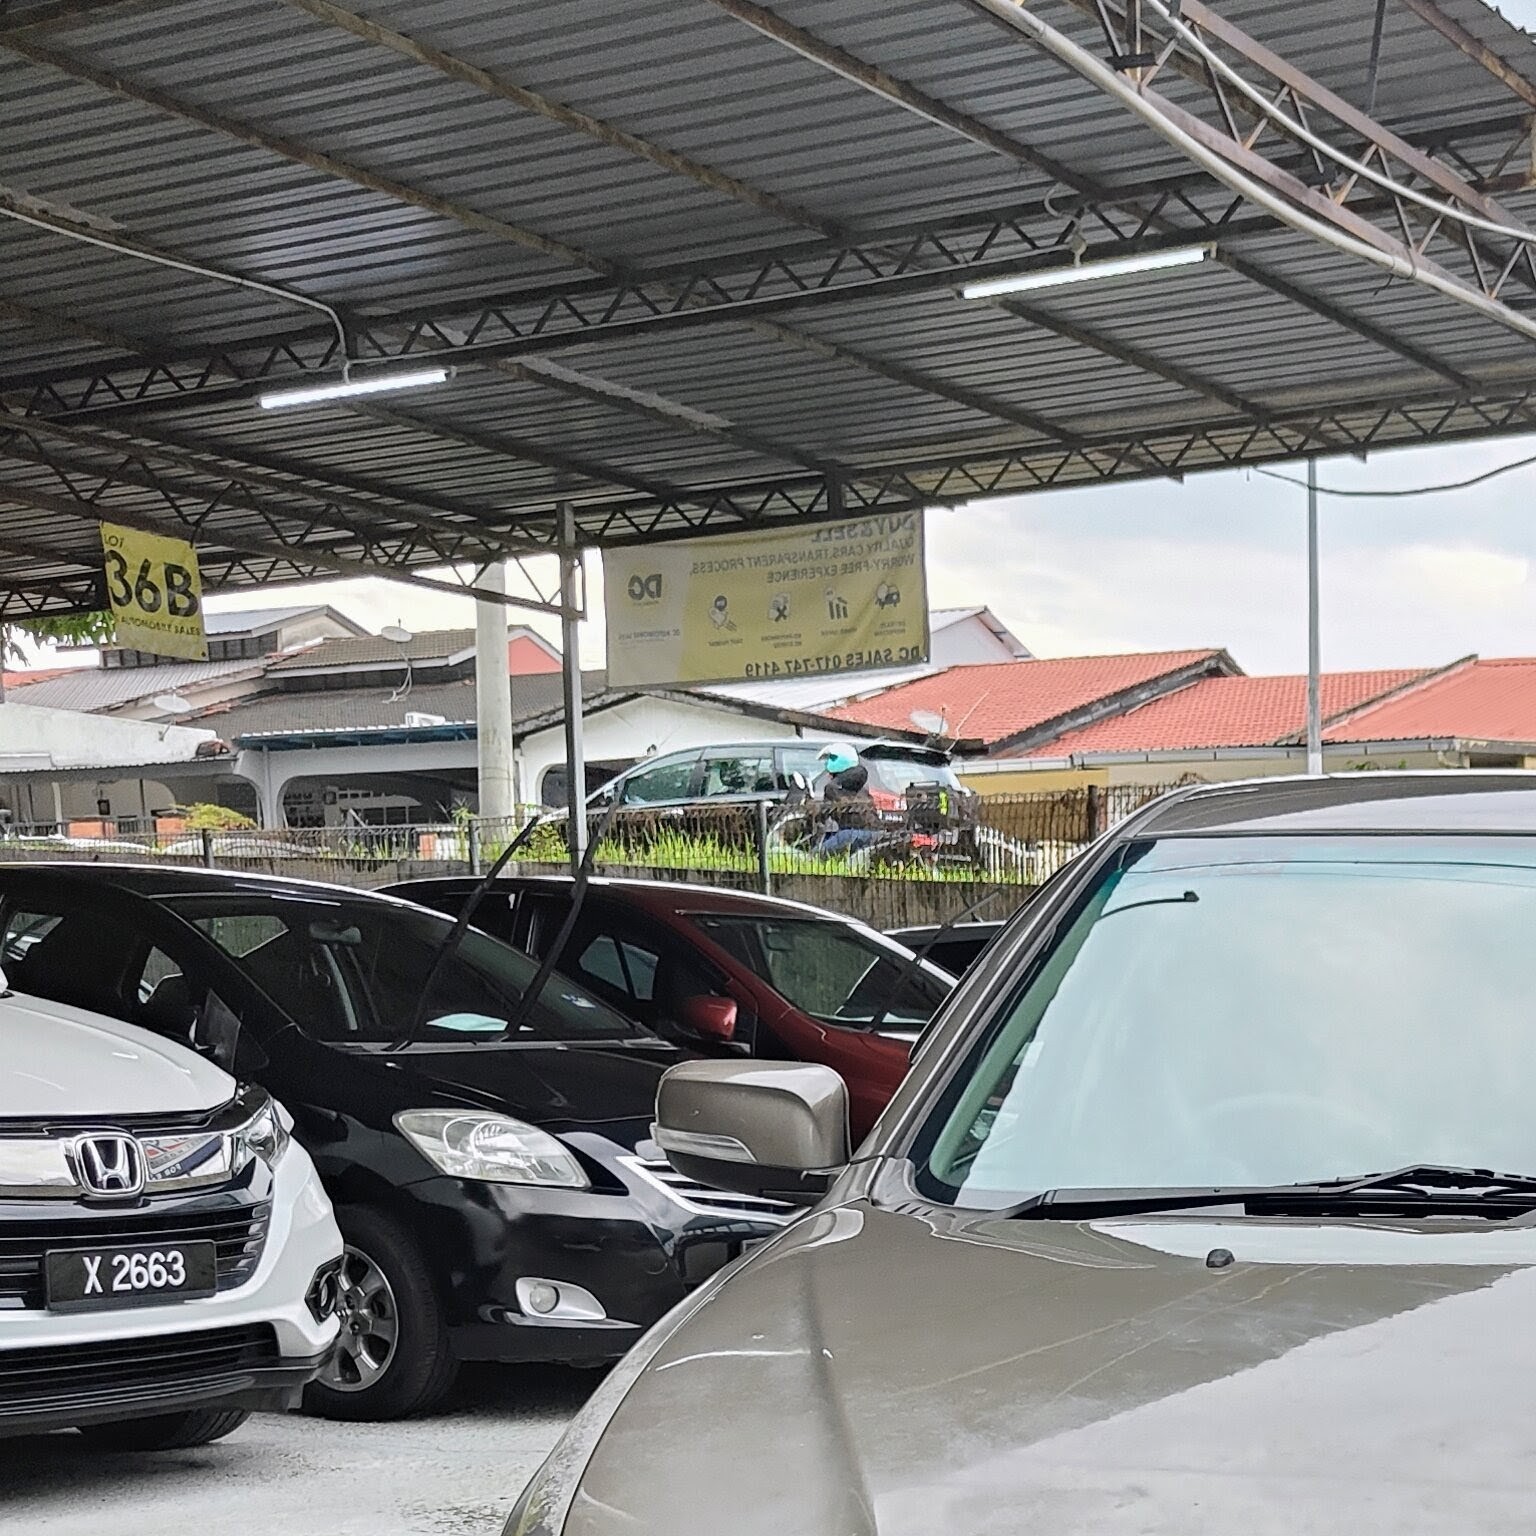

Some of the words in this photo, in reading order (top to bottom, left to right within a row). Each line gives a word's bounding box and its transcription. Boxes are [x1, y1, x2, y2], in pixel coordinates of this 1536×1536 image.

[104, 549, 199, 618] 36B
[174, 624, 201, 636] SALES
[82, 1255, 104, 1295] X
[111, 1250, 187, 1292] 2663
